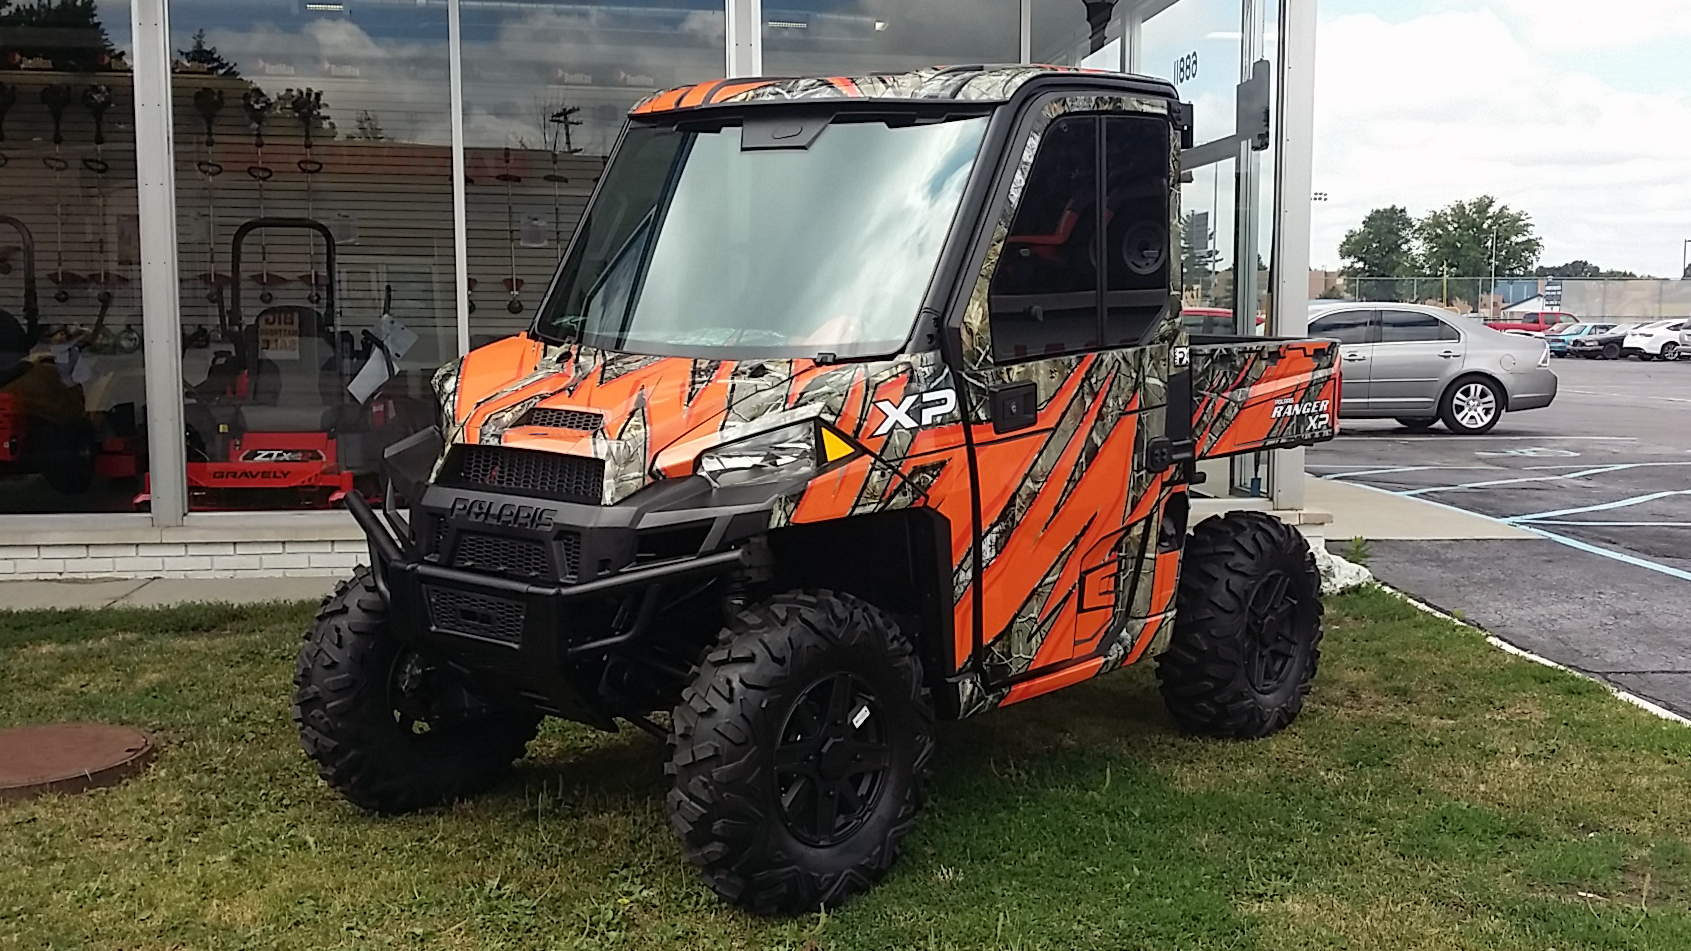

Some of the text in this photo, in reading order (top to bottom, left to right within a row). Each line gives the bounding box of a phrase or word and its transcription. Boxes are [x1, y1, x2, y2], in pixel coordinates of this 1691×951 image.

[872, 388, 957, 437] XP
[1270, 400, 1330, 418] RANGER
[1305, 413, 1330, 431] XP
[212, 470, 291, 479] GRAVELY
[450, 497, 558, 532] POLARIS
